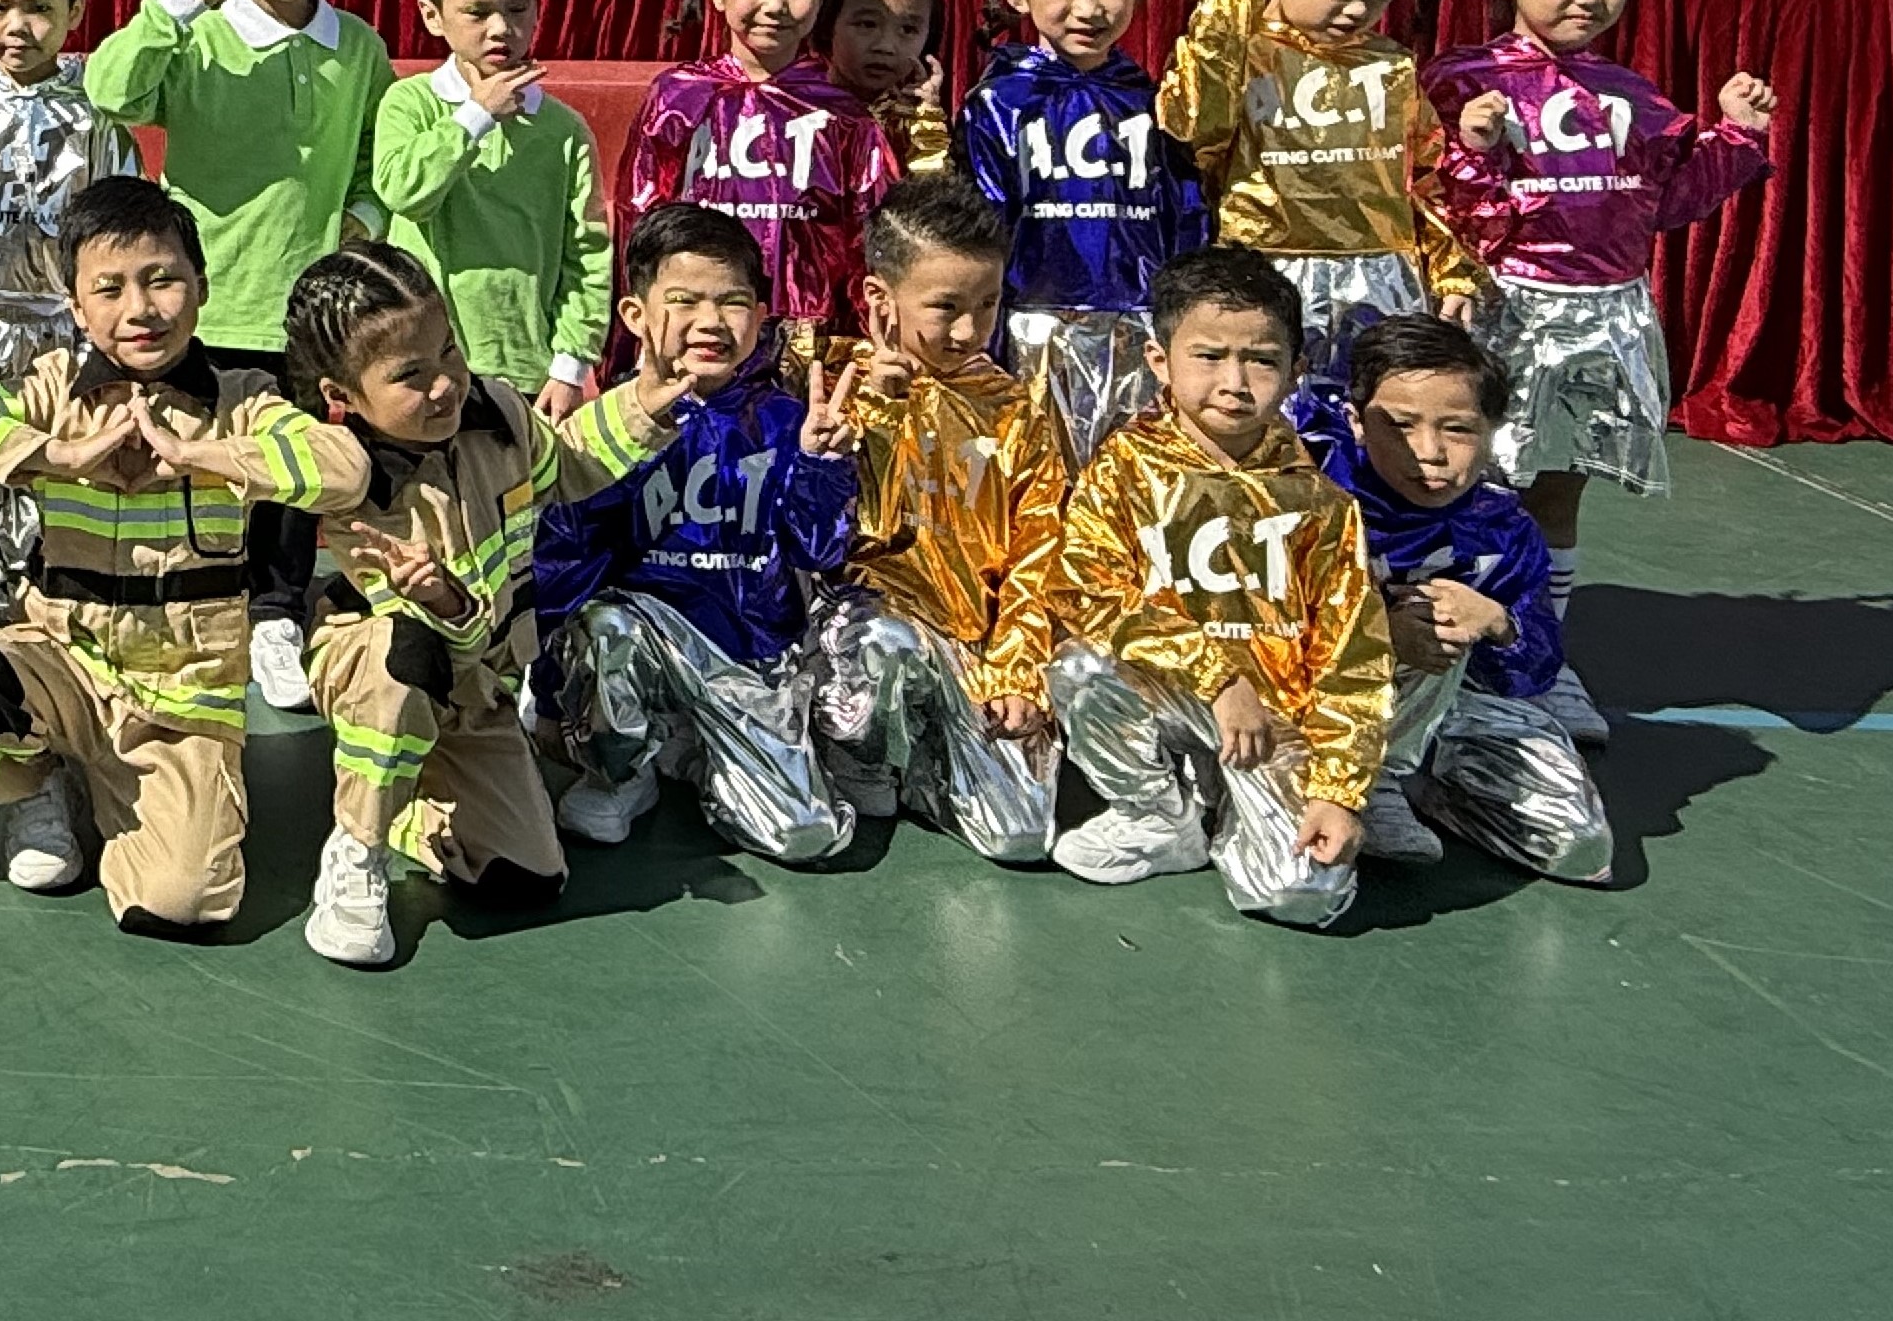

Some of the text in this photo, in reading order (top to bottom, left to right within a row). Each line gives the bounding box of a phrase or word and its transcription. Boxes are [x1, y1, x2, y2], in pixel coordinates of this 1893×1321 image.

[1246, 62, 1393, 132] A.C.T
[681, 110, 829, 199] A.C.T
[1019, 113, 1153, 197] A.C.T
[1260, 151, 1308, 165] CTING
[1311, 148, 1355, 162] CUTE
[1511, 178, 1557, 192] CTING
[1560, 177, 1603, 191] CUTE
[1075, 203, 1116, 218] CUTE
[643, 448, 777, 540] A.C.T
[1203, 622, 1252, 639] CUTE
